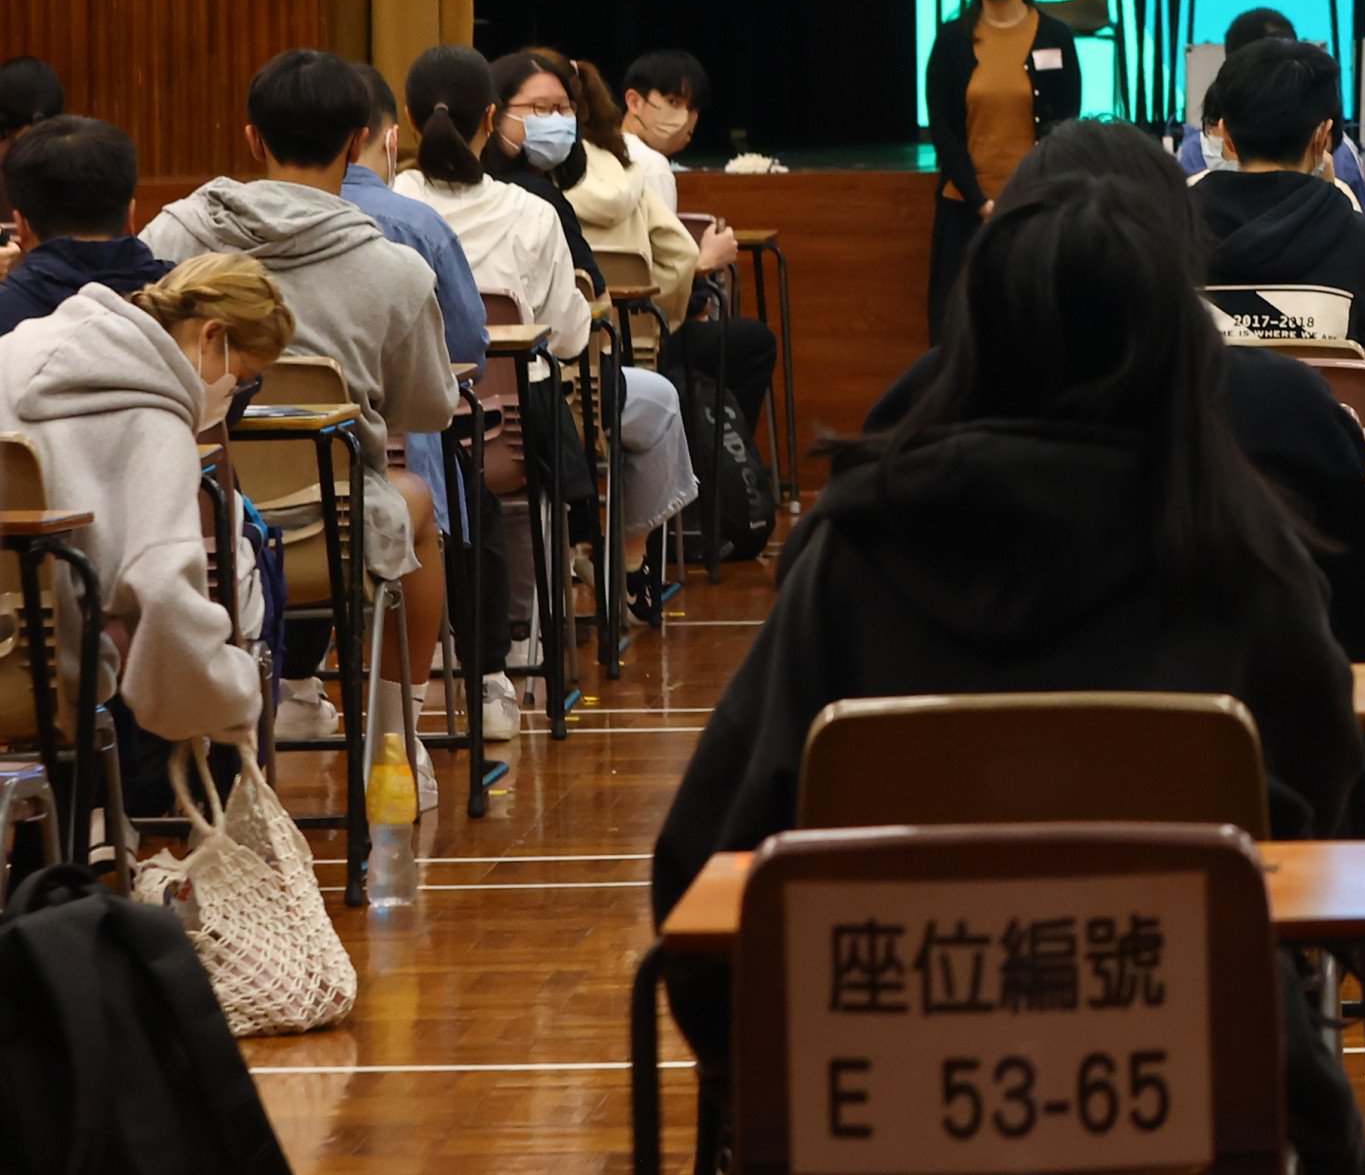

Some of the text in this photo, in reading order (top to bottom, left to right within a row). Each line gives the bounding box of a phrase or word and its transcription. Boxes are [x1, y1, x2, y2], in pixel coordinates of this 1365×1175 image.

[1233, 314, 1315, 329] 2017-2018
[1238, 330, 1250, 338] IS
[1254, 329, 1298, 339] WHERE
[828, 911, 1168, 1017] 座位編號
[826, 1049, 1174, 1144] E 53-65
